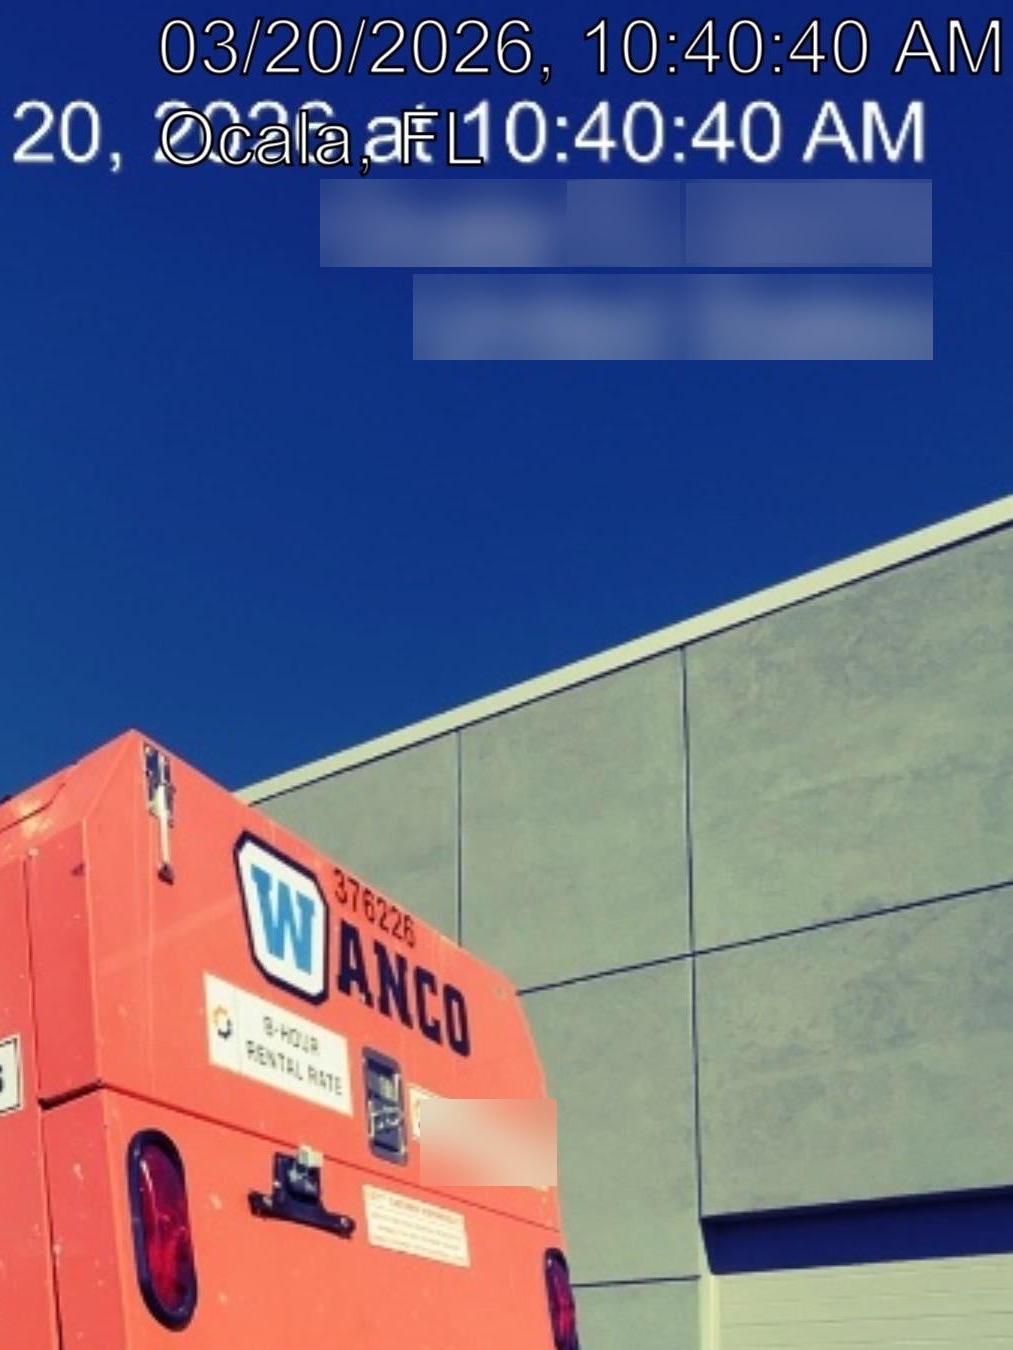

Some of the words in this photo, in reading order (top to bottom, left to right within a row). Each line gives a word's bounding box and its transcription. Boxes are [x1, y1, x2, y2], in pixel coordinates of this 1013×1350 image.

[333, 866, 416, 949] 376226
[263, 1015, 319, 1056] 8-HOUR
[246, 1039, 304, 1082] RENTAL
[307, 1063, 343, 1097] RATE
